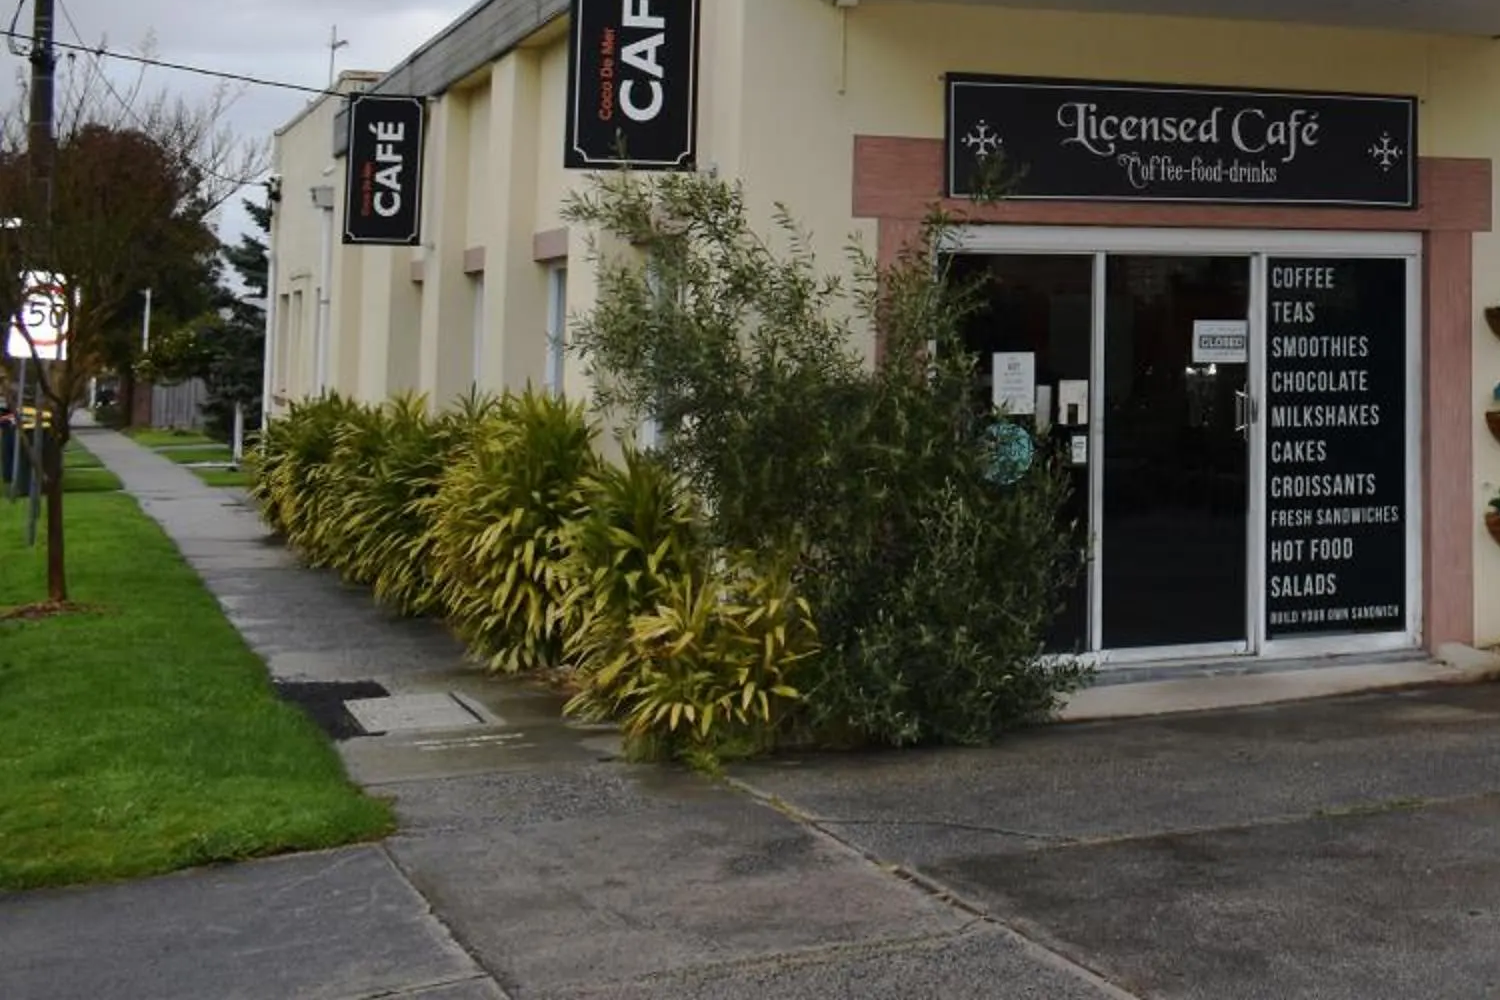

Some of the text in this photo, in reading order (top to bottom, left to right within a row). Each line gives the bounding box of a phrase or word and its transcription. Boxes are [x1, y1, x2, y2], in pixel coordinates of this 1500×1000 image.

[598, 80, 613, 121] Coco
[1057, 102, 1320, 162] Licensed Café
[368, 121, 405, 217] CAFÉ
[1272, 267, 1335, 289] COFFEE
[1271, 301, 1316, 324] TEAS
[1271, 335, 1369, 358] SMOOTHIES
[1271, 370, 1369, 393] CHOCOLATE
[1271, 404, 1380, 428] MILKSHAKES
[1271, 440, 1327, 463] CAKES
[1271, 473, 1377, 498] CROISSANTS
[1271, 505, 1399, 527] FRESH SANDWICHES
[1271, 537, 1354, 563] HOT FOOD
[1271, 573, 1338, 598] SALADS
